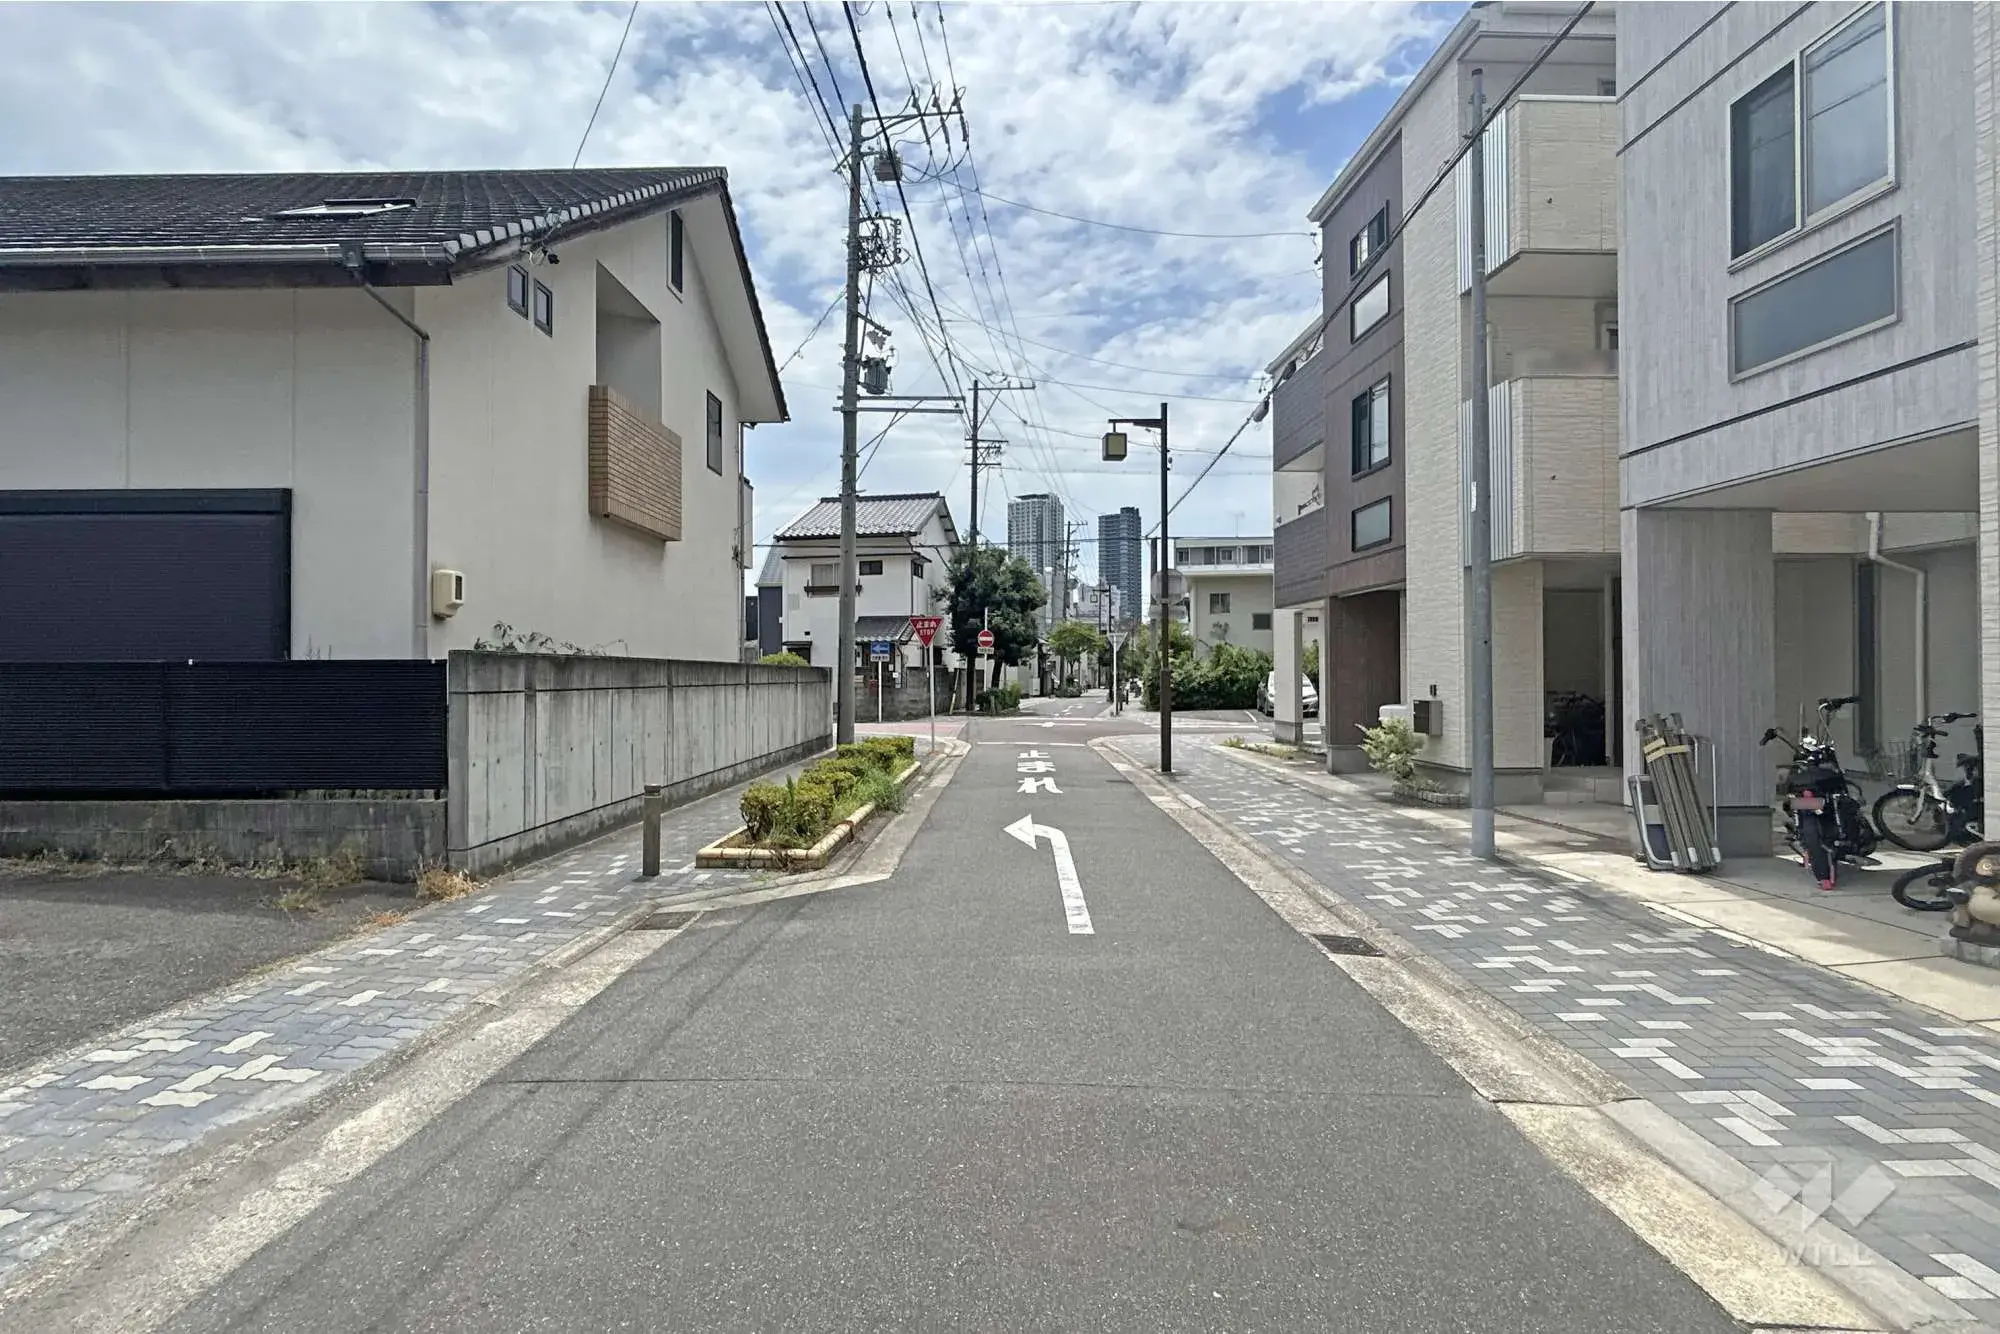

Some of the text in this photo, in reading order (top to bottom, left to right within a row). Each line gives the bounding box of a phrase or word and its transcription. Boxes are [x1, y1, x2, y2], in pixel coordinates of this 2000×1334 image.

[916, 620, 937, 629] 止まれ
[1017, 750, 1064, 794] 止まれ
